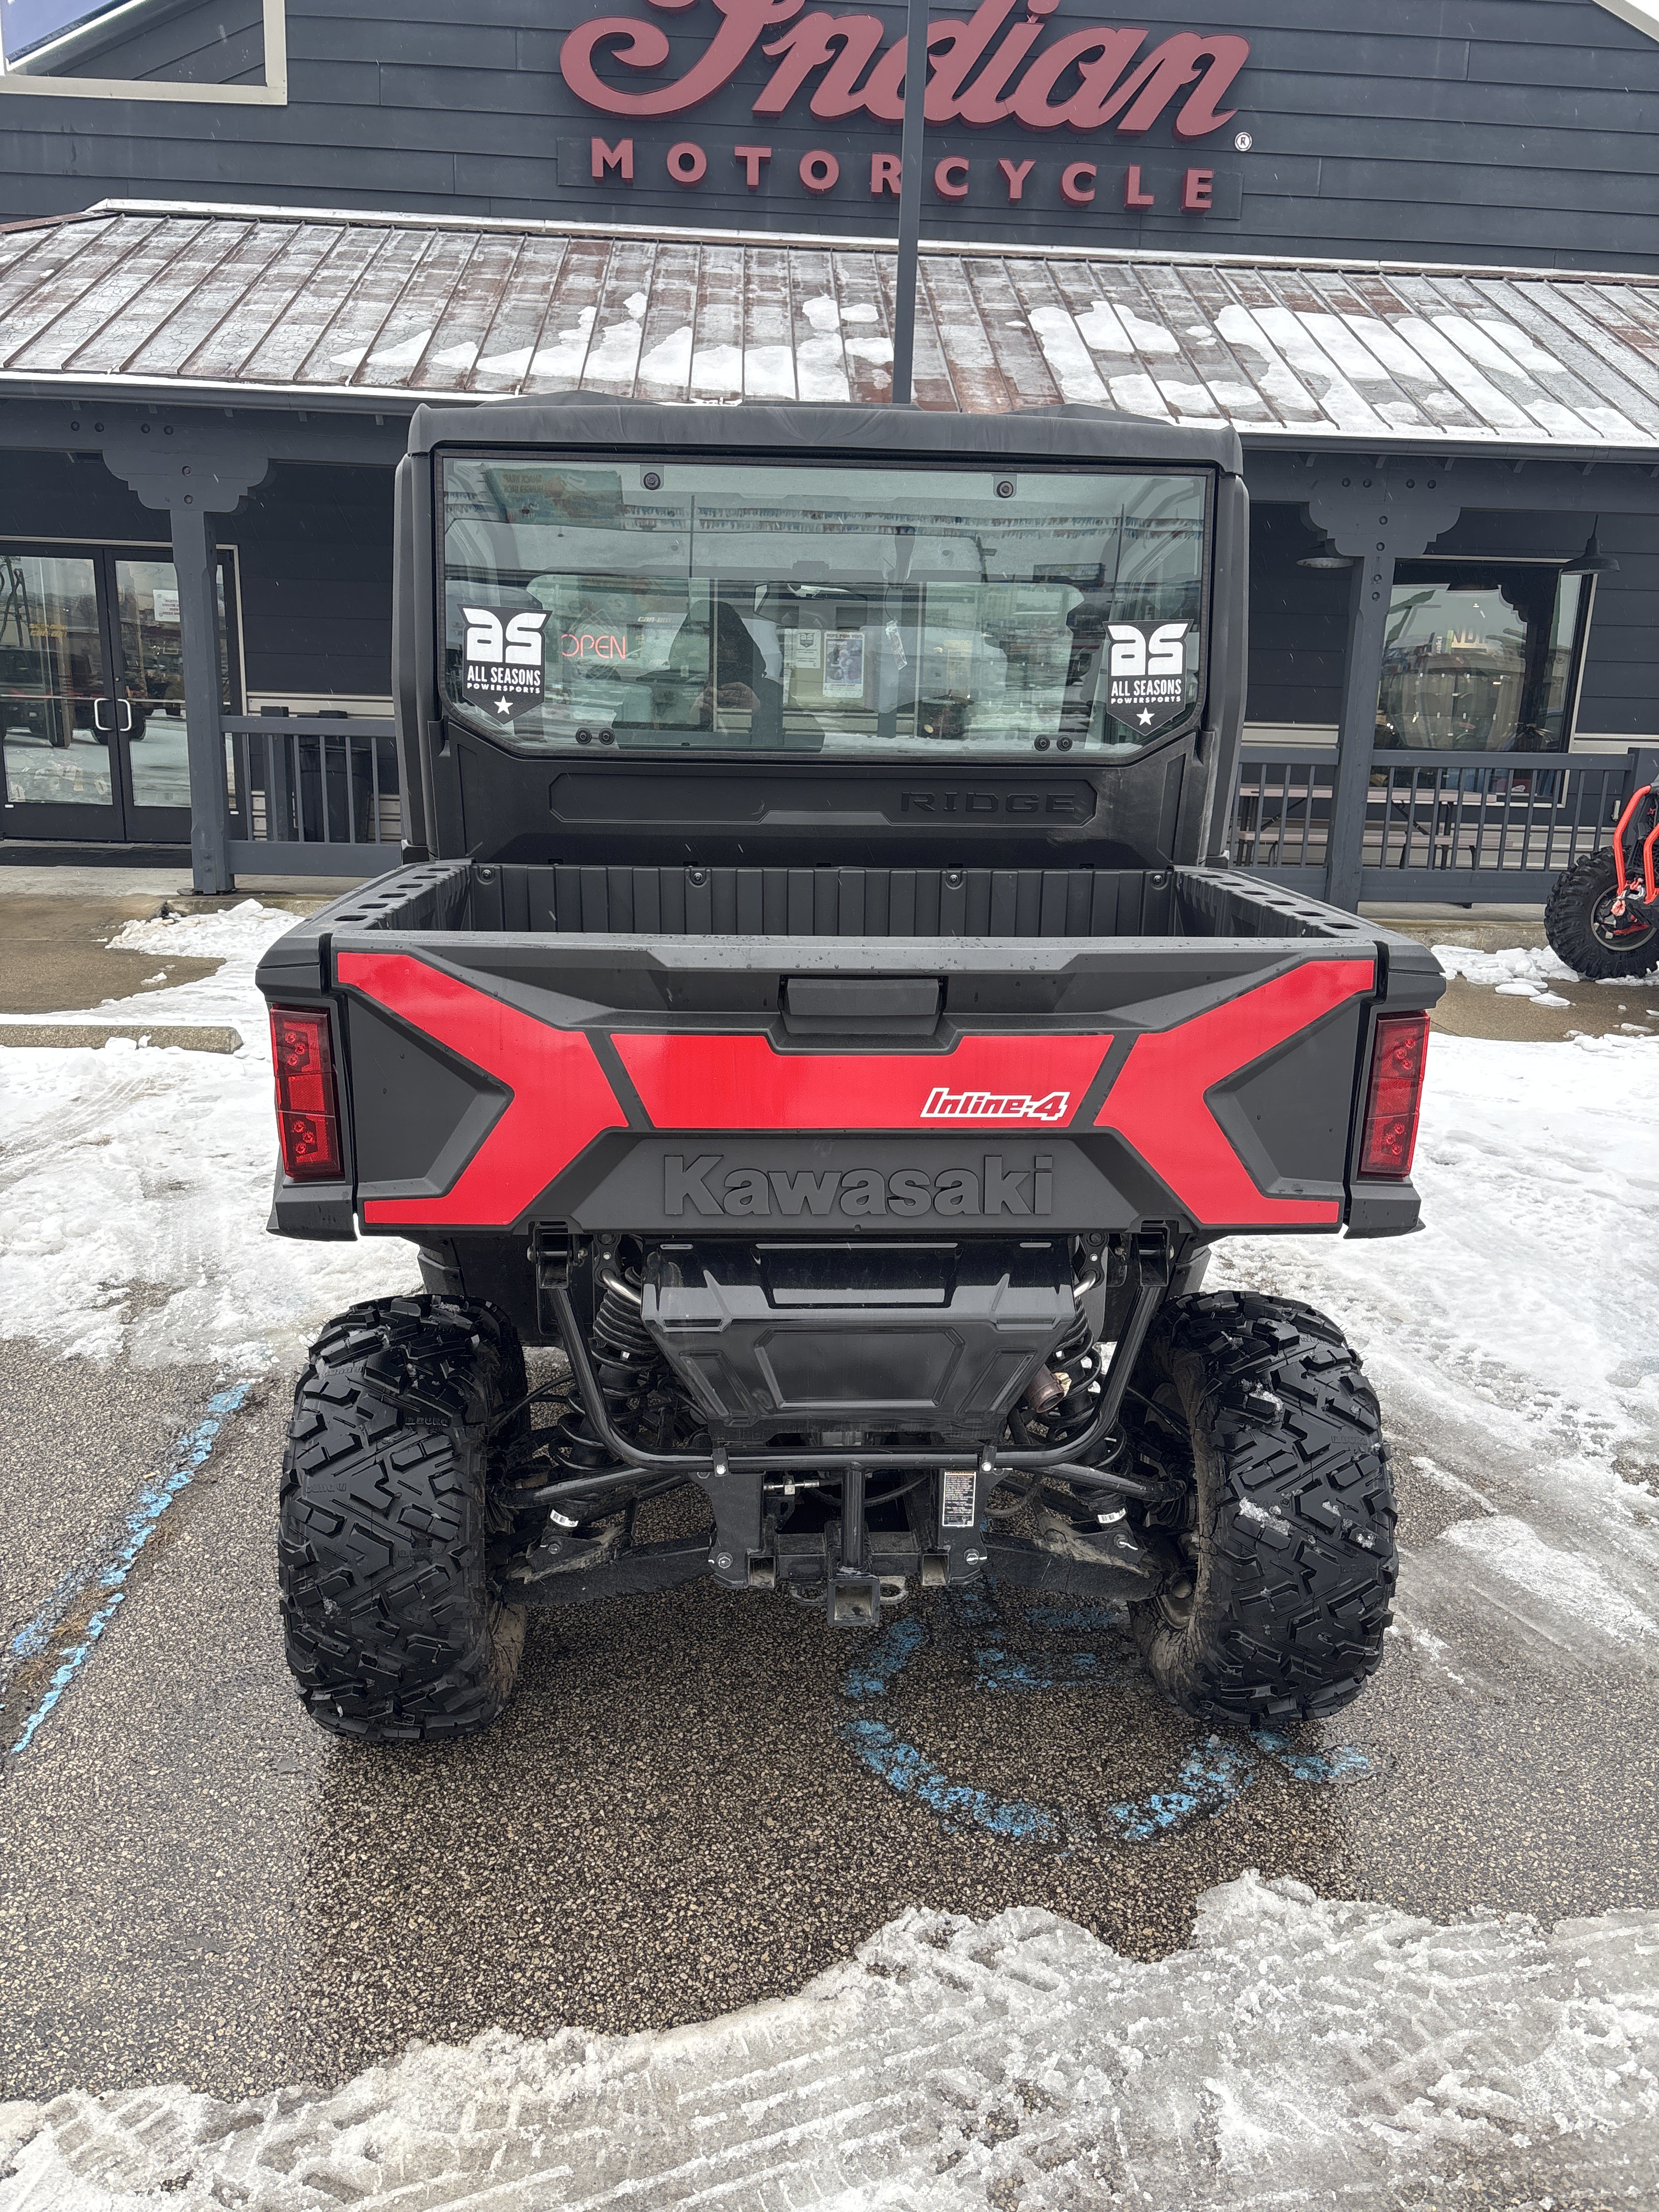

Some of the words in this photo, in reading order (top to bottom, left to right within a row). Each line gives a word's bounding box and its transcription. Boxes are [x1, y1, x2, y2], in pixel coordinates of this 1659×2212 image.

[590, 137, 1215, 214] MOTORCYCLE
[561, 634, 626, 659] OPEN
[467, 665, 487, 682] ALL
[490, 667, 541, 686] SEASONS
[467, 682, 540, 694] POWERSPORTS
[1111, 680, 1130, 696] ALL
[1133, 679, 1182, 696] SEASONS
[1110, 696, 1181, 704] POWERSPORTS
[901, 792, 1076, 812] RIDGE
[920, 1087, 1070, 1121] Inline-4
[663, 1153, 1053, 1216] Kawasaki
